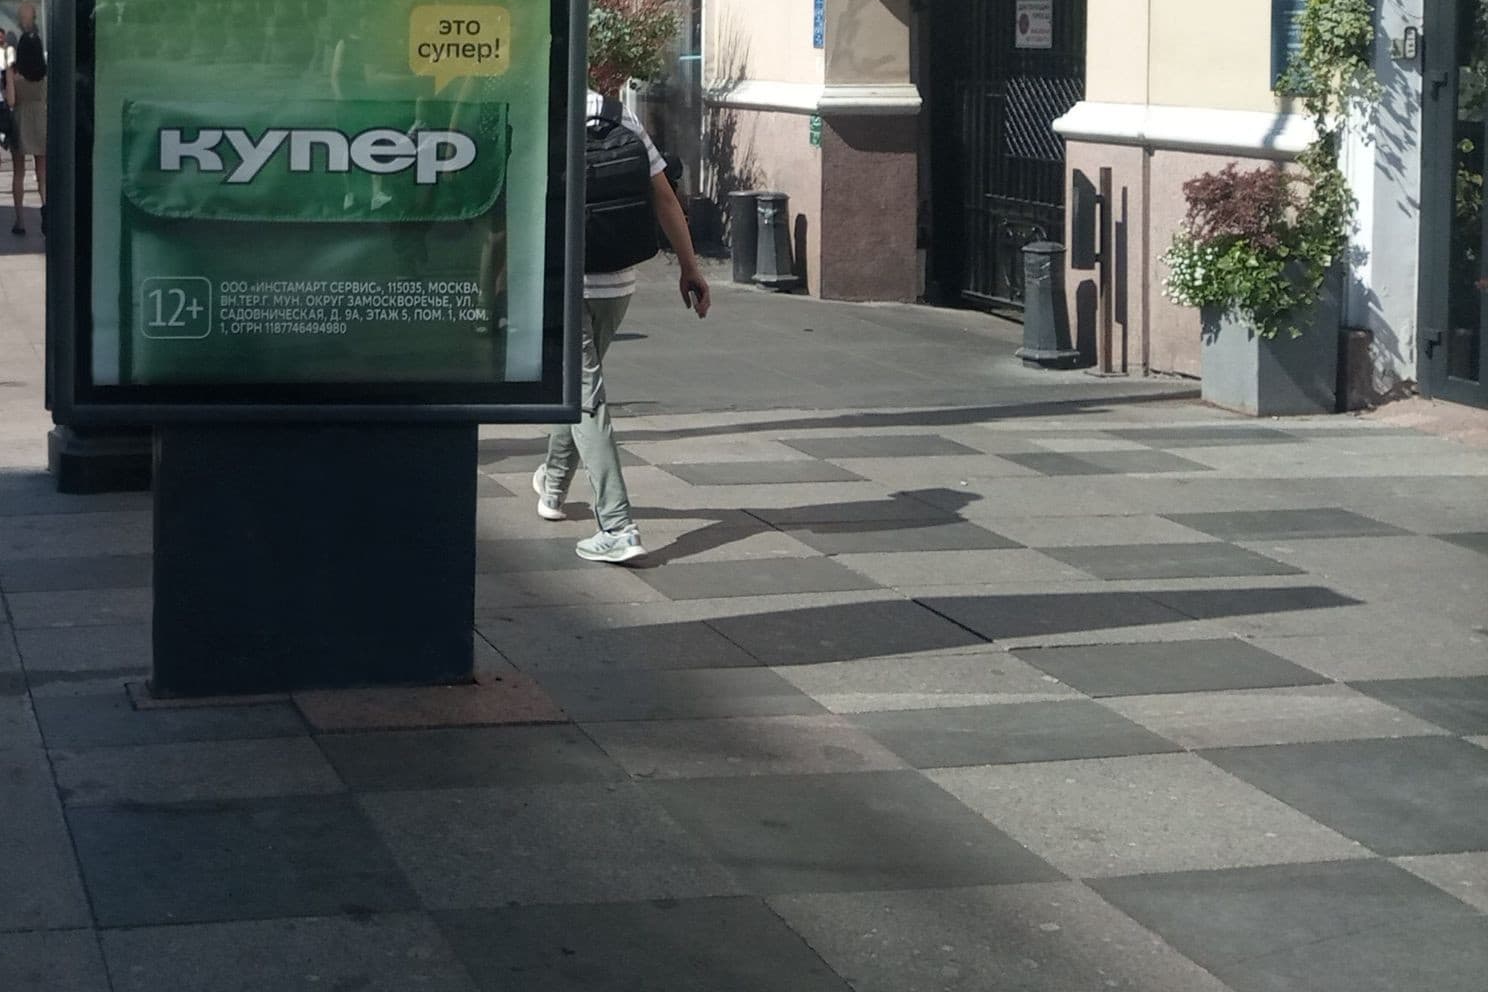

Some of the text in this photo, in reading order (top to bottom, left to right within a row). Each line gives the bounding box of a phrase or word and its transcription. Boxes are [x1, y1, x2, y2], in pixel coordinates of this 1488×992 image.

[438, 17, 482, 36] это
[417, 37, 502, 64] супер!
[158, 127, 478, 186] купер
[220, 281, 248, 293] ООО
[387, 282, 426, 295] 115035,
[428, 282, 482, 296] МОСКВА,
[148, 288, 204, 327] 12+
[305, 295, 345, 307] ОКРУГ
[346, 295, 453, 308] ЗАМОСКВОРЕЧЬЕ,
[220, 309, 327, 321] САДОВНИЧЕСКАЯ,
[365, 309, 399, 321] ЭТАЖ
[458, 309, 489, 321] КОМ.
[231, 322, 263, 334] ОГРН
